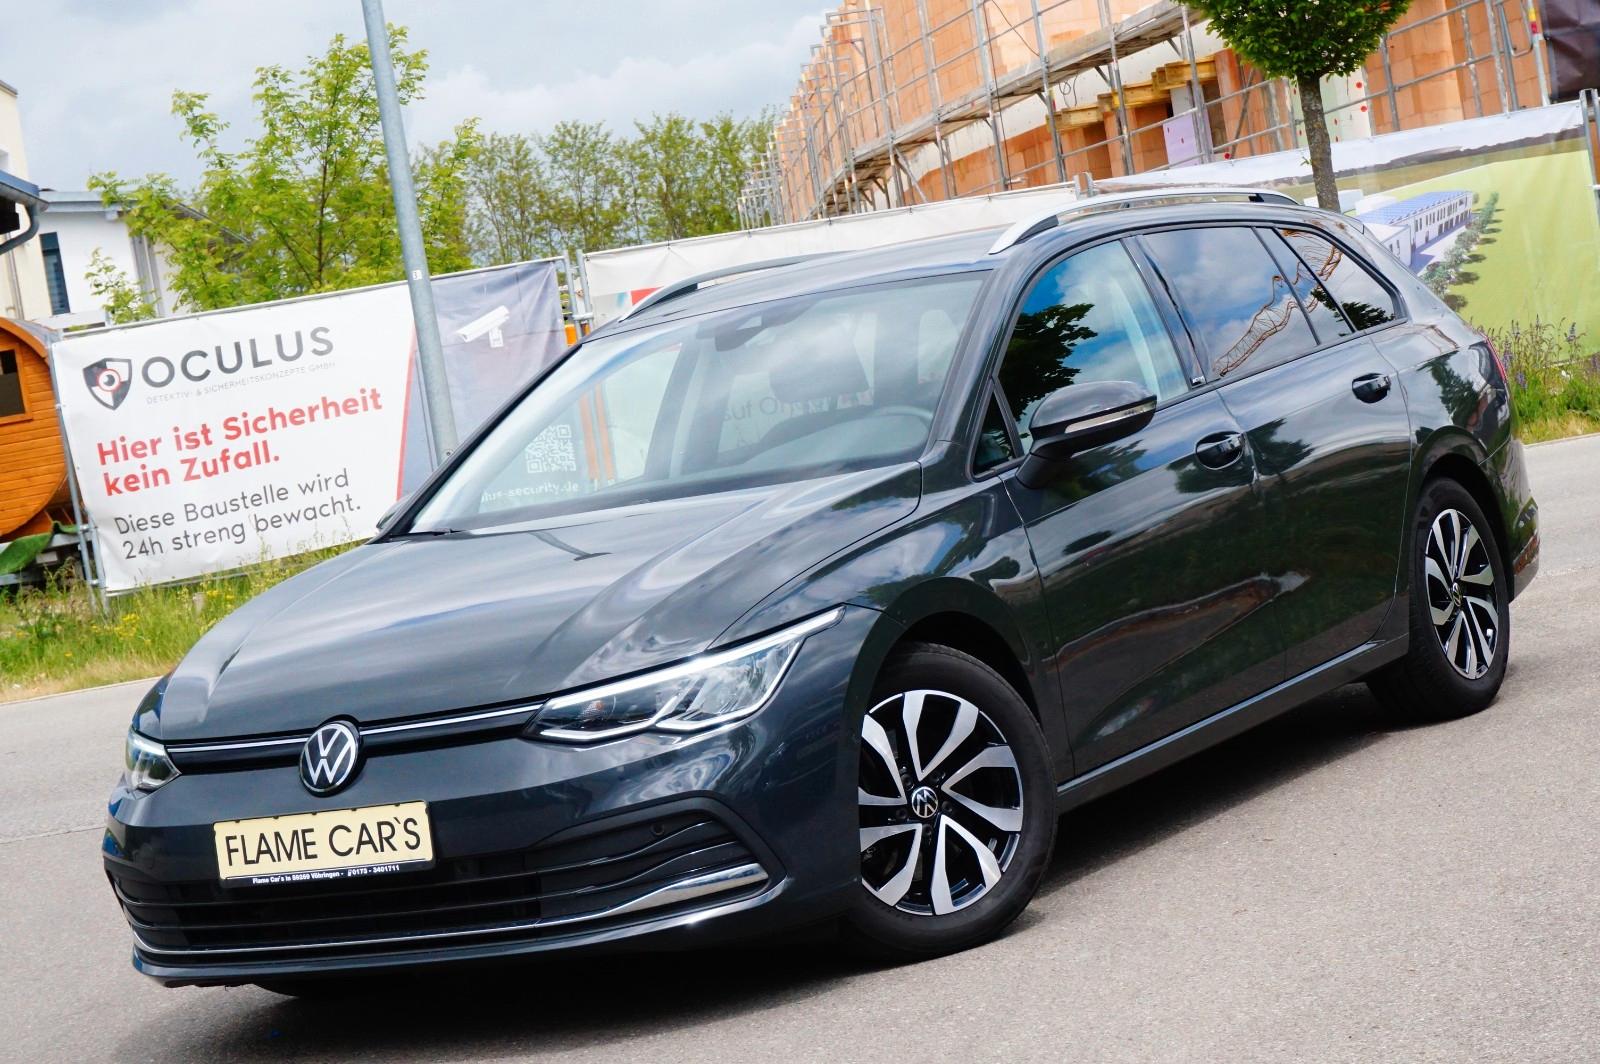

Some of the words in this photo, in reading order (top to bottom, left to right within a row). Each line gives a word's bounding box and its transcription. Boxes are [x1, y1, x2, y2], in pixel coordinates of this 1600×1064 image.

[141, 326, 334, 388] OCULUS
[204, 367, 306, 395] SICHERHEITSKONZEPTE
[97, 434, 162, 466] Hier
[173, 423, 213, 452] ist
[223, 388, 383, 442] Sicherheit
[103, 462, 171, 497] kein
[180, 440, 280, 482] Zufall.
[114, 511, 175, 535] Diese
[184, 484, 289, 523] Baustelle
[298, 468, 350, 496] wird
[122, 537, 163, 560] 24h
[172, 520, 246, 551] streng
[254, 495, 361, 533] bewacht.
[225, 828, 318, 867] FLAME
[252, 877, 270, 885] Flame
[311, 871, 340, 880] Vöhringen
